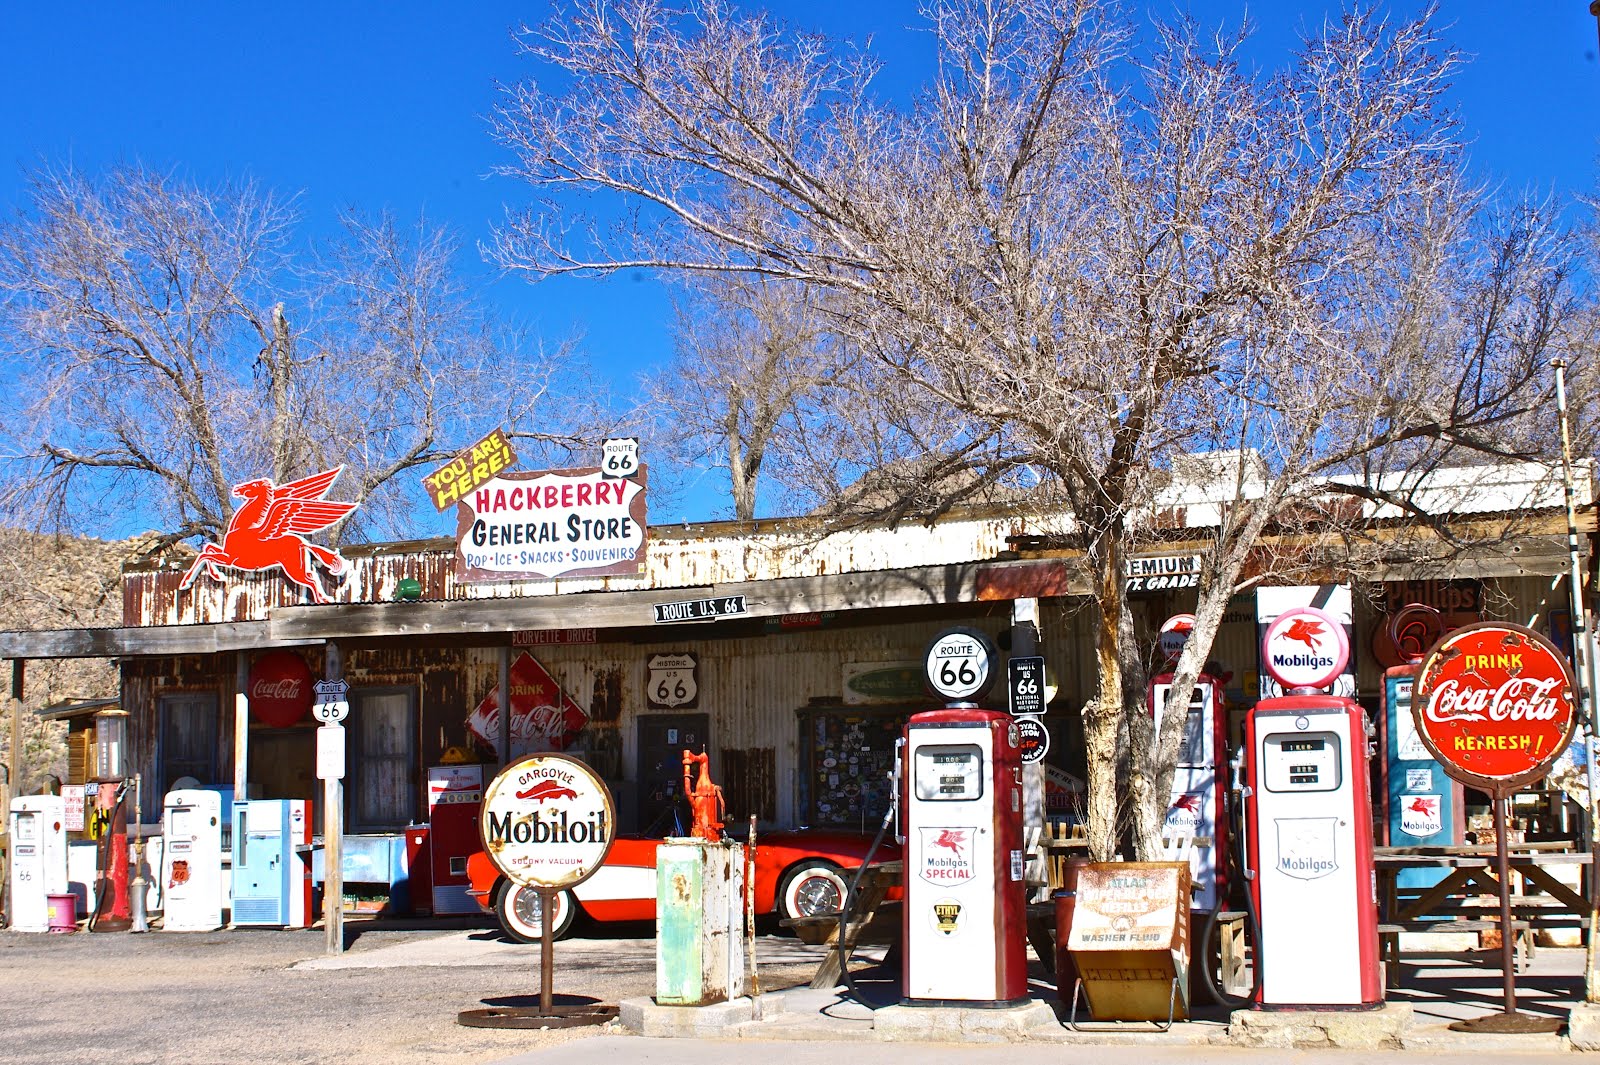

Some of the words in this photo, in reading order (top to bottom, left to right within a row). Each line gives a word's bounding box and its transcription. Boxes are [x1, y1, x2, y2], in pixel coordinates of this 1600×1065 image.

[606, 444, 633, 453] ROUTE
[429, 460, 466, 489] YOU
[472, 433, 504, 465] ARE
[608, 455, 631, 470] 66
[437, 445, 511, 509] HERE!
[476, 479, 626, 513] HACKBERRY
[472, 518, 560, 546] GENERAL
[567, 514, 631, 542] STORE
[521, 550, 564, 564] SNACKS
[571, 547, 636, 562] SOUVENIRS
[1129, 557, 1194, 575] EMIUM
[1147, 574, 1200, 590] GRADE
[1387, 580, 1476, 617] Phillips
[662, 603, 694, 620] ROUTE
[700, 602, 719, 617] U.S.
[724, 598, 738, 614] 66
[516, 630, 562, 644] CORVETTE
[566, 629, 594, 643] DRIVE
[940, 644, 973, 656] ROUTE
[1017, 662, 1035, 670] ROUTE
[1274, 653, 1334, 670] Mobilgas
[1466, 654, 1523, 669] DRINK
[940, 660, 976, 686] 66
[253, 678, 302, 699] Coca-Cola
[322, 684, 341, 692] ROUTE
[658, 679, 686, 699] 66
[1017, 679, 1037, 694] 66
[1426, 677, 1562, 722] Coca-Cola
[322, 703, 340, 718] 66
[518, 768, 575, 785] GARGOYLE
[1048, 769, 1074, 784] WE'RE
[488, 810, 606, 843] Mobiloil
[1168, 818, 1202, 827] Mobilgas
[1404, 821, 1439, 831] Mobilgas
[928, 857, 968, 868] Mobilgas
[1282, 857, 1334, 873] Mobilgas
[20, 870, 32, 881] 66
[174, 871, 184, 879] 66
[926, 868, 970, 879] SPECIAL
[936, 906, 958, 915] ETHYL
[1082, 934, 1125, 942] WASHER
